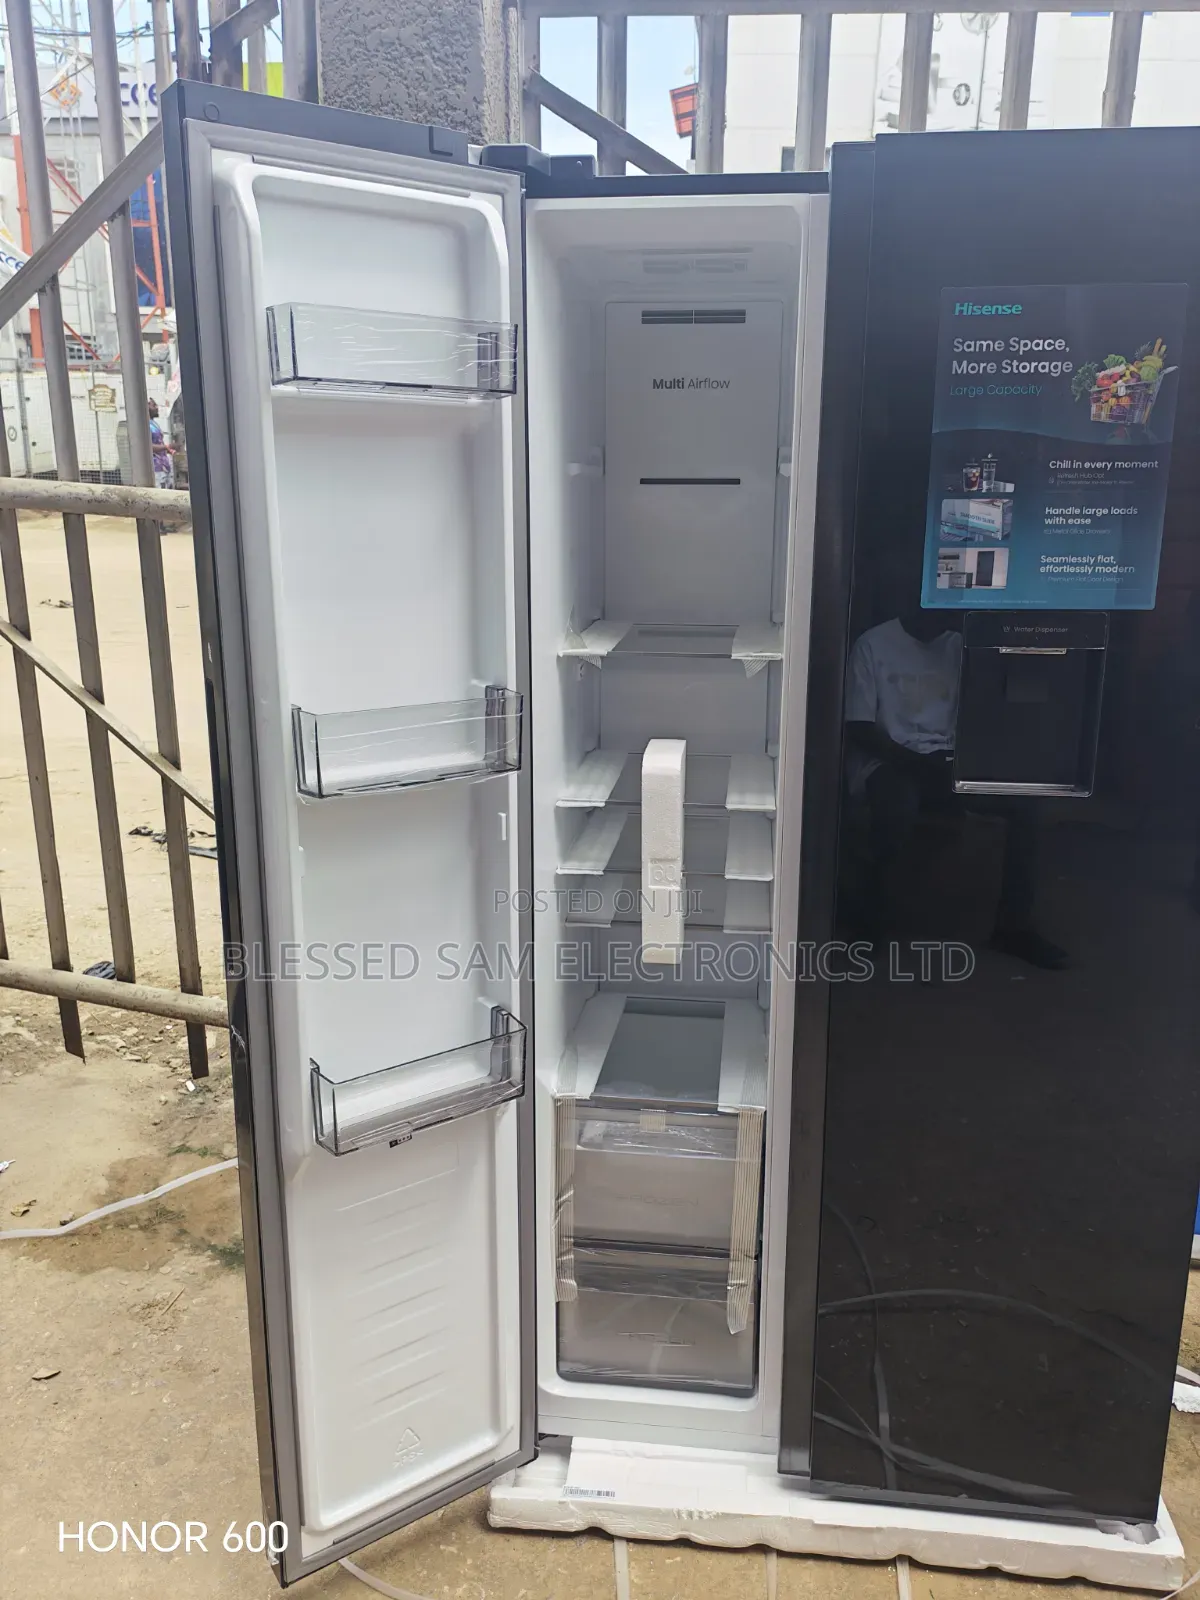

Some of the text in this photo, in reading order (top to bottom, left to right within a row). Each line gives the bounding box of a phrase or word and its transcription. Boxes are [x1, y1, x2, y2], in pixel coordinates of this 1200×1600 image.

[954, 302, 1023, 316] Hisense
[953, 337, 1070, 355] Same Space,
[952, 358, 1073, 377] More Storage
[652, 377, 731, 390] Multi Airflow
[950, 383, 1042, 398] Large Capacity
[1049, 460, 1159, 471] Chill in every moment
[1045, 506, 1138, 517] Handle large loads
[1044, 516, 1092, 525] with ease
[1040, 555, 1117, 565] Seamlessly flat,
[1039, 564, 1135, 575] effortlessly modern
[1035, 626, 1069, 634] Dispenser
